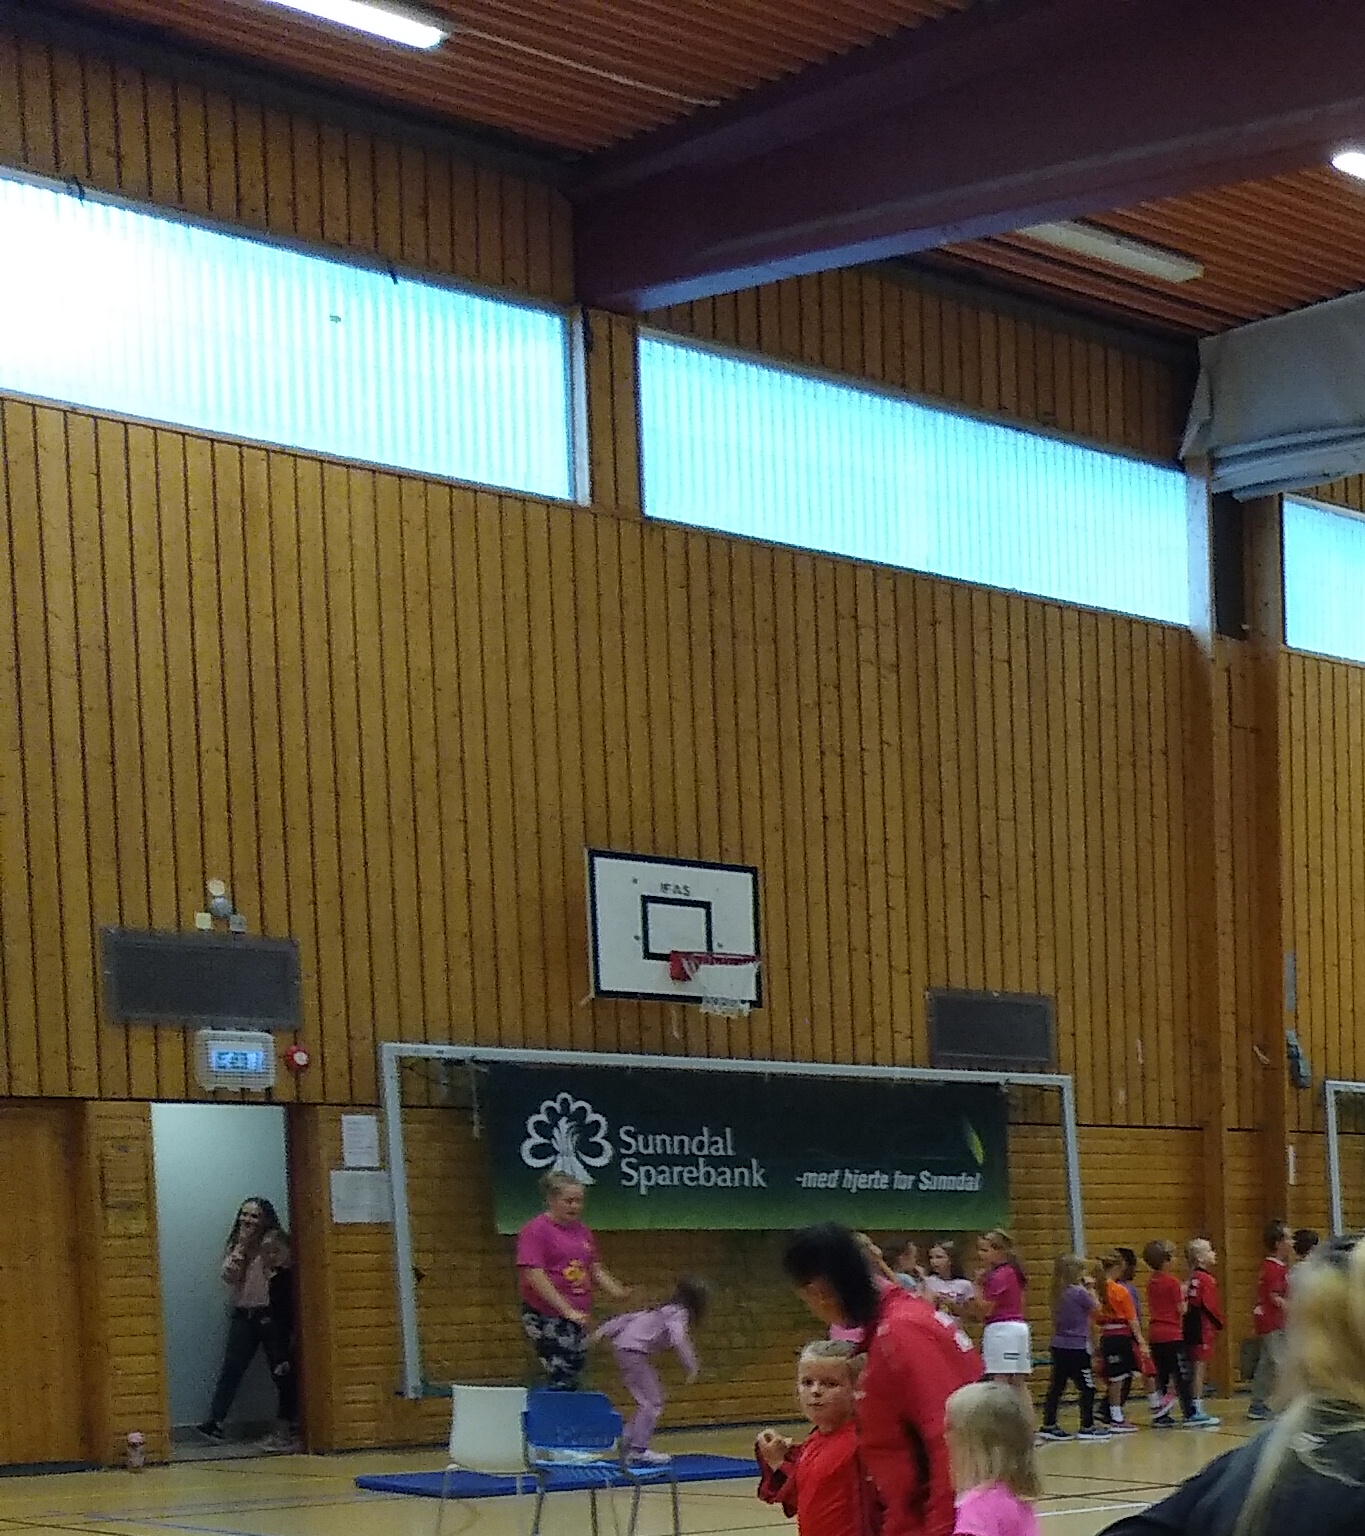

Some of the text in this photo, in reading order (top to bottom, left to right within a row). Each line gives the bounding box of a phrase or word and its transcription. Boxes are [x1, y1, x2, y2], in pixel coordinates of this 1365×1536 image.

[619, 1125, 736, 1156] Sunndal
[620, 1157, 767, 1196] Sparebank
[841, 1169, 889, 1193] hjerte
[918, 1169, 981, 1191] Sunndal
